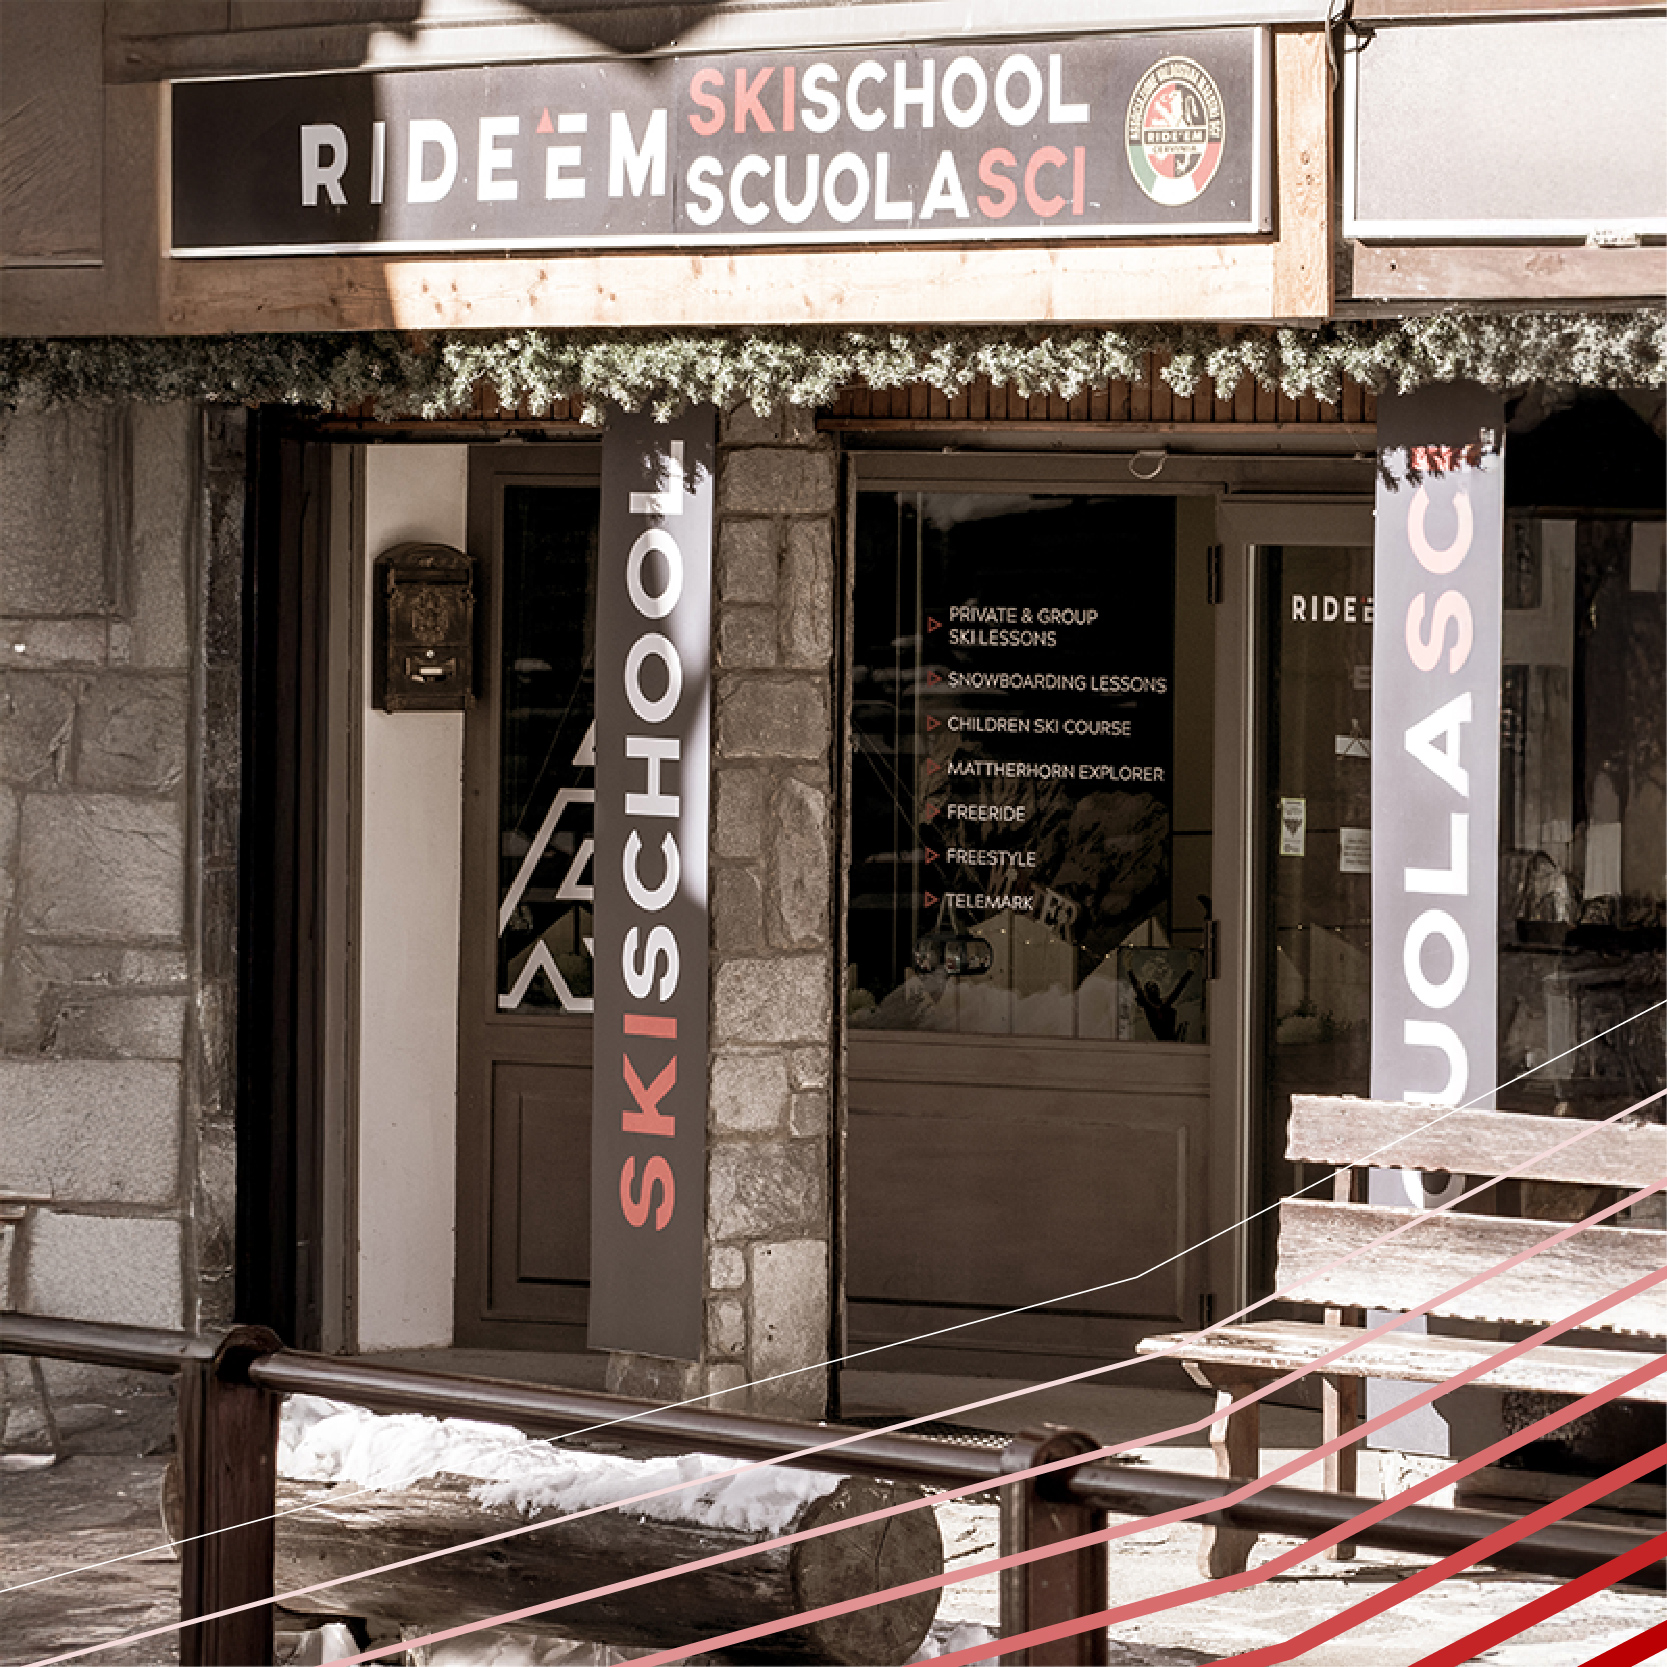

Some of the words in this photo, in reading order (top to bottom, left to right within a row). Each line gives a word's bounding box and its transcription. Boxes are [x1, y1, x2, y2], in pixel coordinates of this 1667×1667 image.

[949, 605, 1018, 623] PRIVATE
[1020, 607, 1034, 624] &
[1036, 607, 1099, 625] GROUP
[949, 628, 976, 645] SKI
[978, 630, 1057, 648] LESSONS
[947, 670, 1088, 691] SNOWBOARDING
[1090, 674, 1168, 694] LESSONS
[947, 715, 1030, 733] CHILDREN
[1032, 718, 1059, 733] SKI
[1062, 719, 1132, 737] COURSE
[947, 760, 1076, 780] MATTHERHORN
[1078, 763, 1166, 782] EXPLORER
[947, 803, 1026, 822] FREERIDE
[946, 847, 1036, 868] FREESTYLE
[945, 892, 1034, 911] TELEMARK
